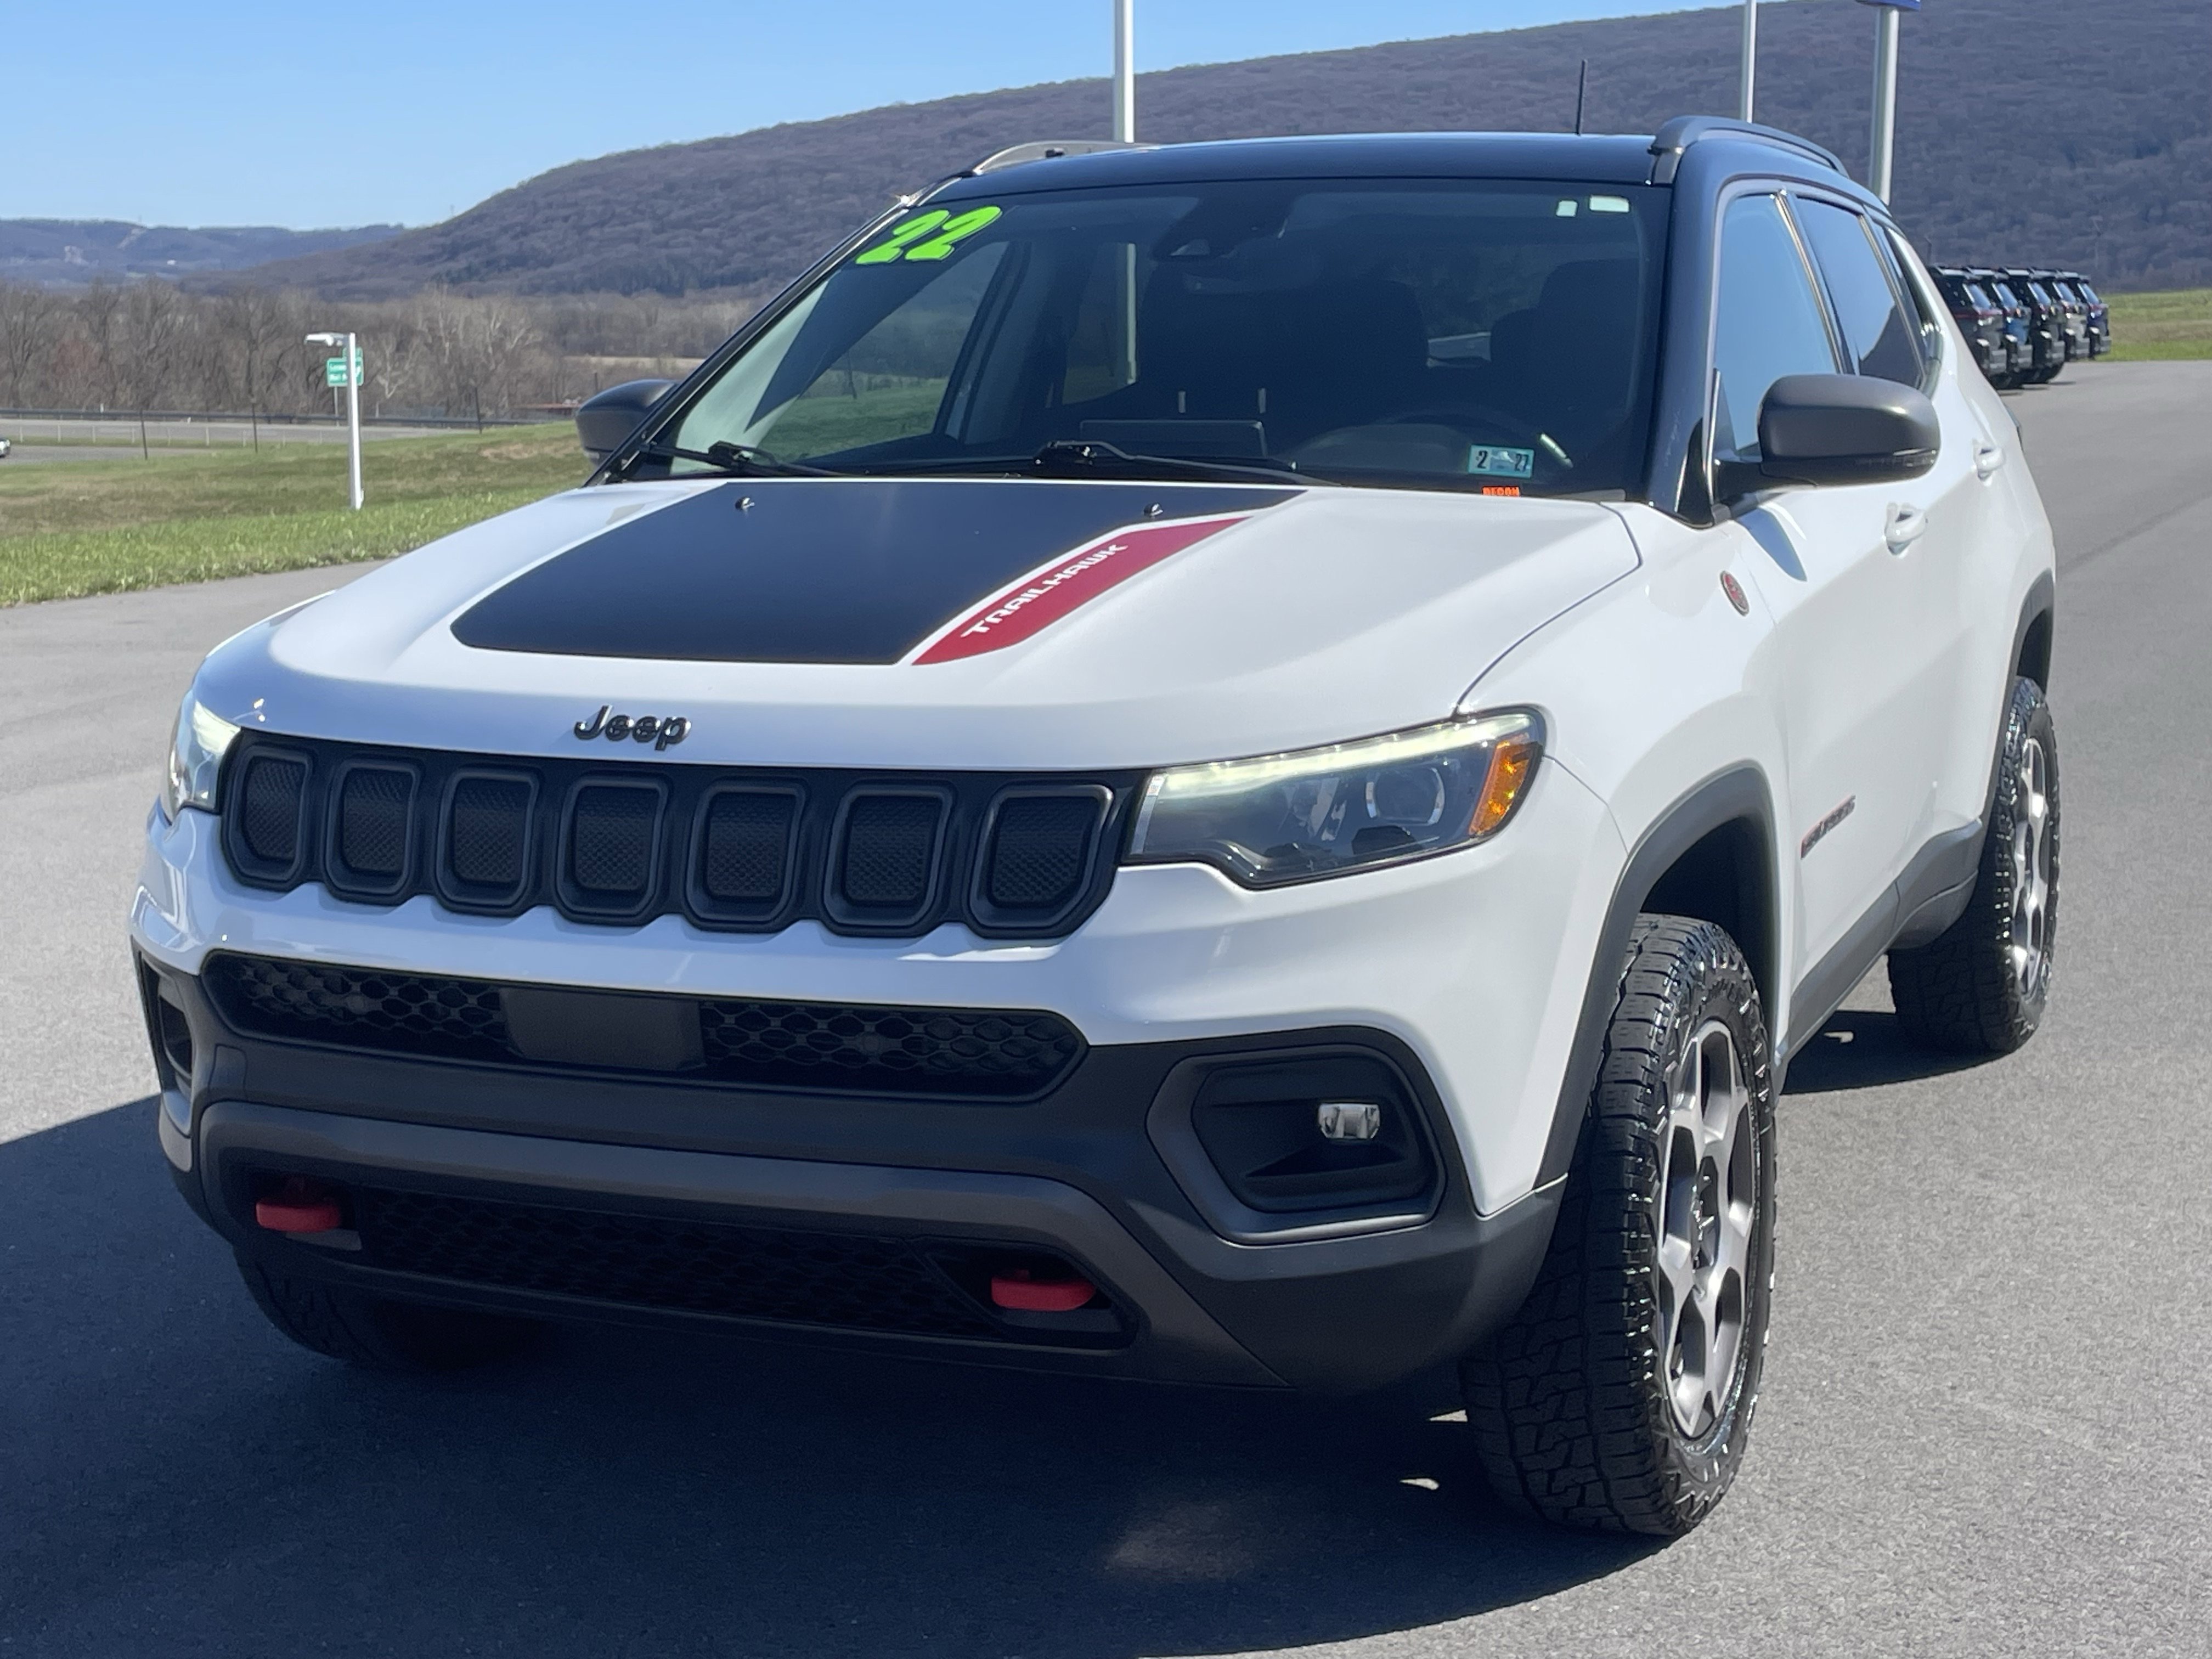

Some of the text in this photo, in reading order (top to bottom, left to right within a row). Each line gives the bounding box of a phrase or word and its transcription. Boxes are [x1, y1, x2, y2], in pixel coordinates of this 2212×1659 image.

[855, 206, 1002, 264] 22
[1477, 450, 1529, 472] 2 27
[961, 544, 1128, 637] TRAILHAWK
[574, 704, 692, 752] Jeep
